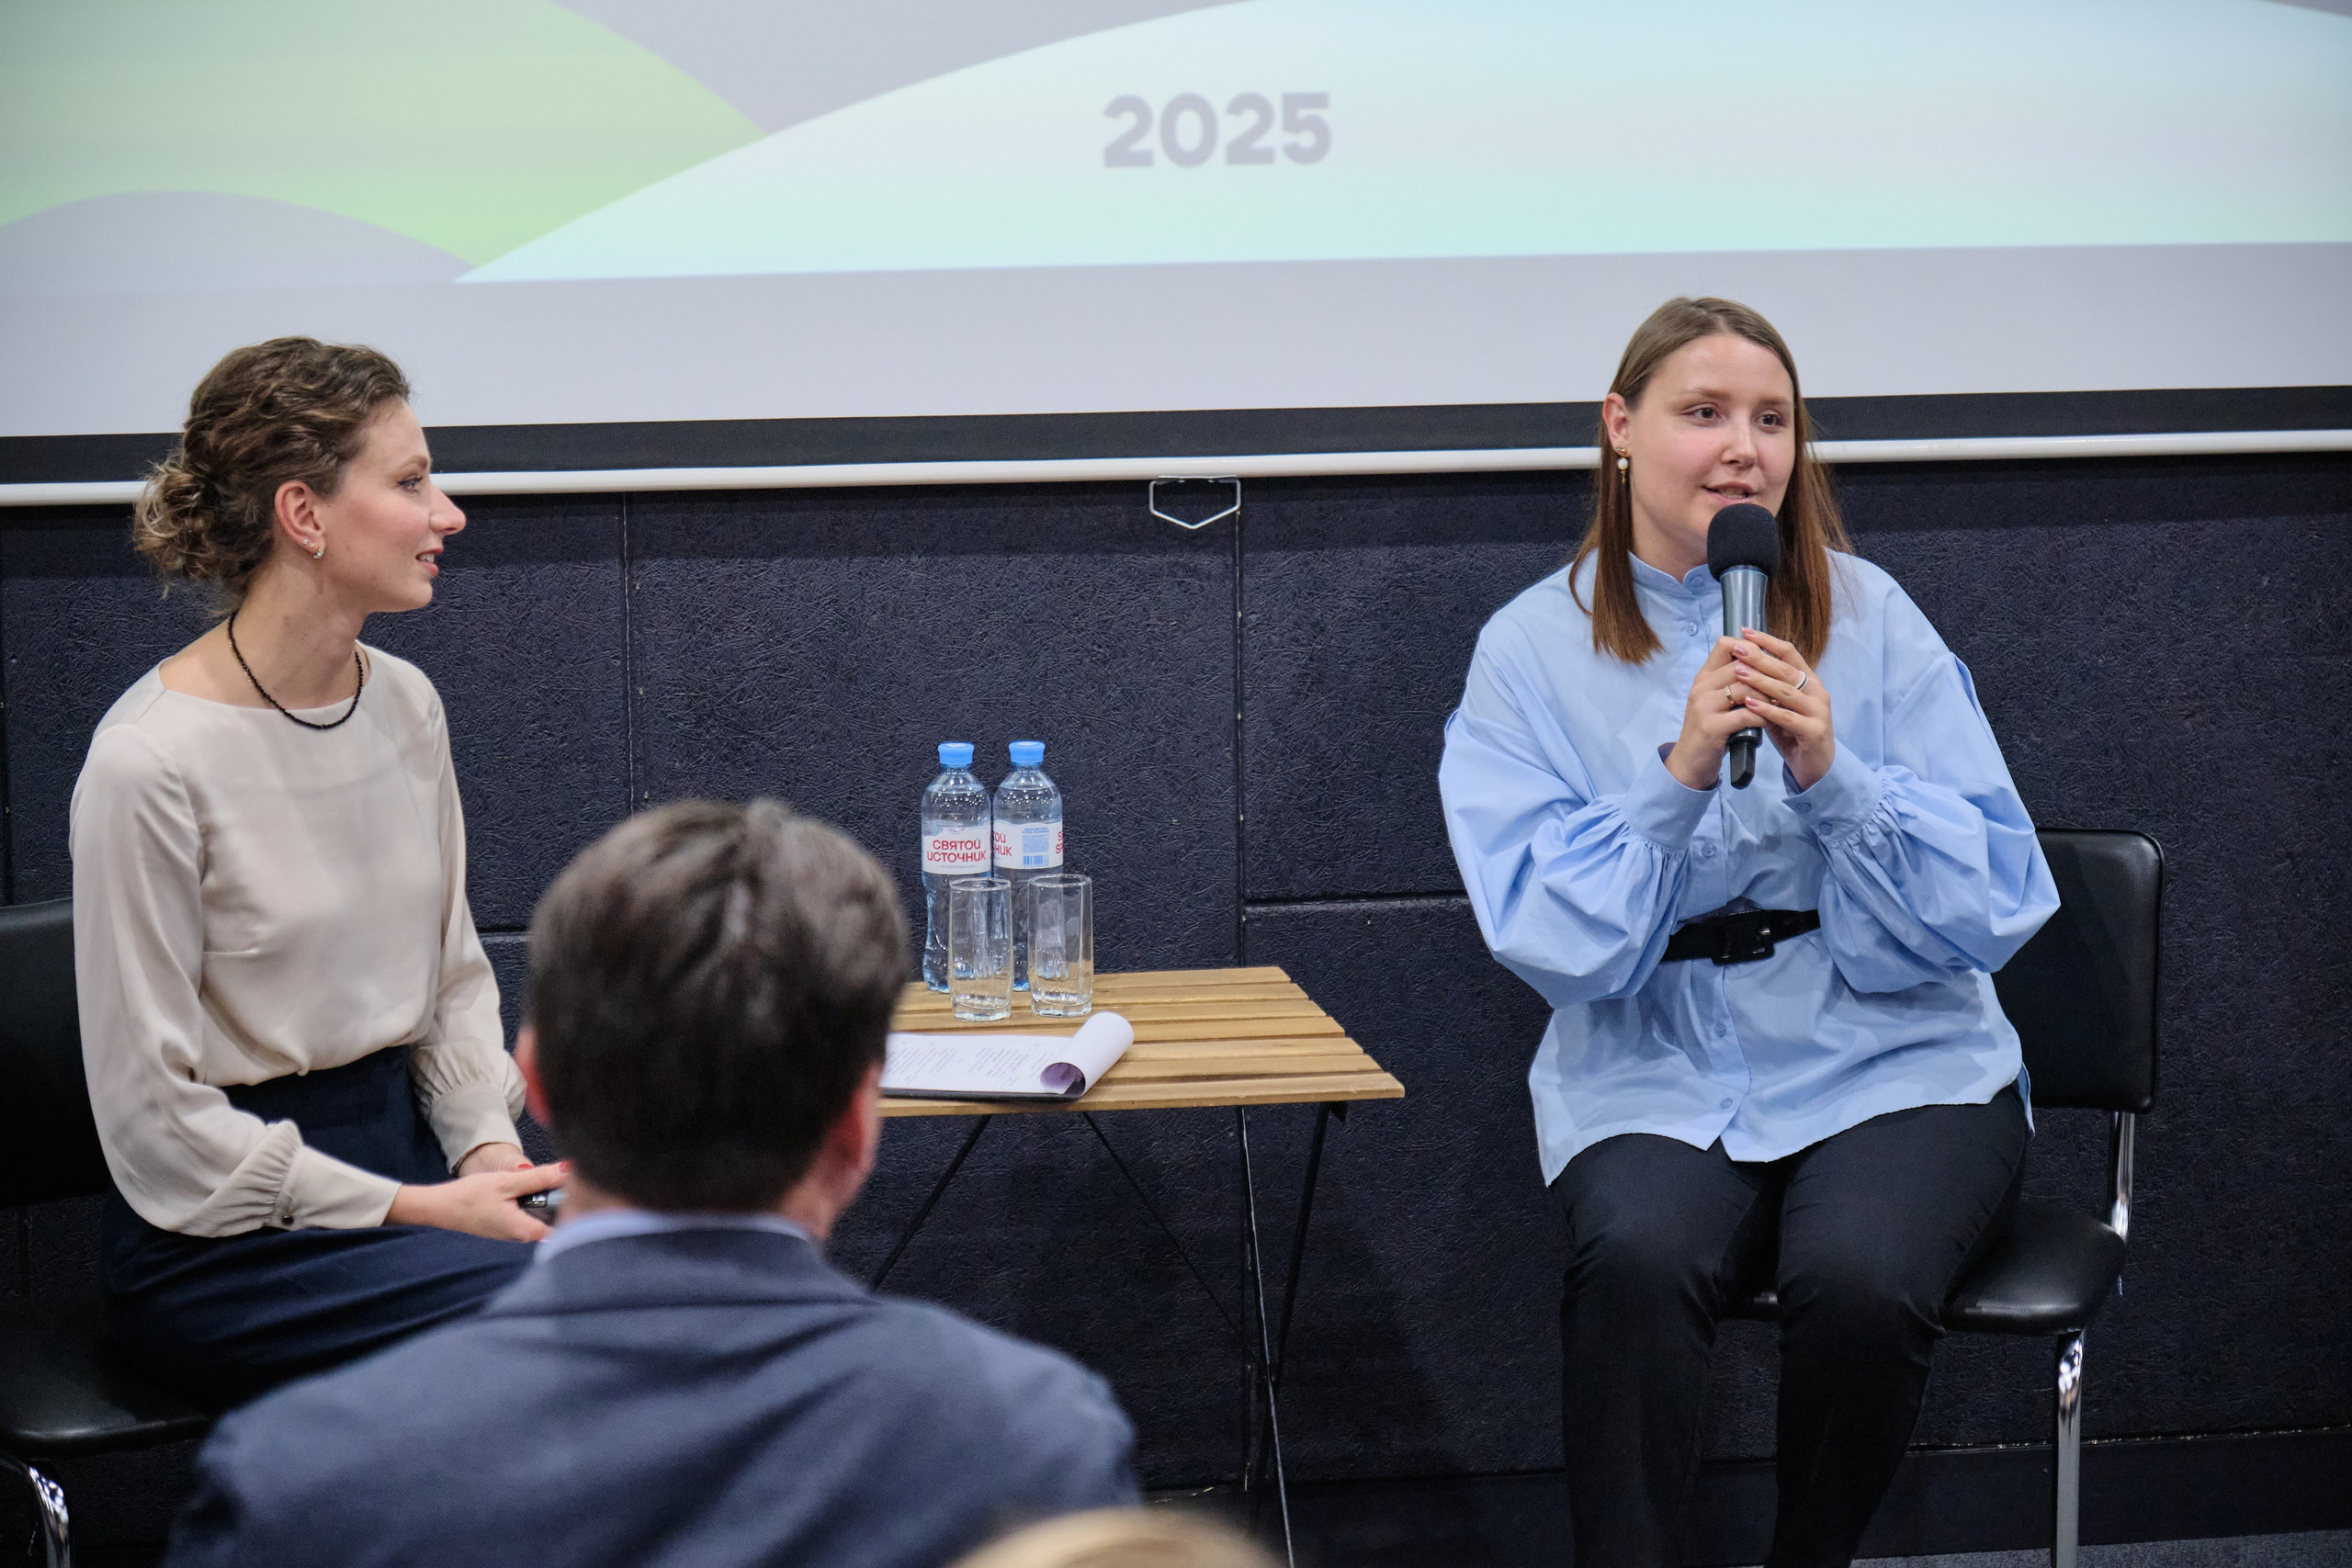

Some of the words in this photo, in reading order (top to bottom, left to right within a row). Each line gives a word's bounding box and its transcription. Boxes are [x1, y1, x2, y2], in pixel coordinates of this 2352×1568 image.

[1102, 92, 1332, 168] 2025
[933, 838, 981, 851] СВЯТОЙ
[927, 851, 987, 863] ИСТОЧНИК
